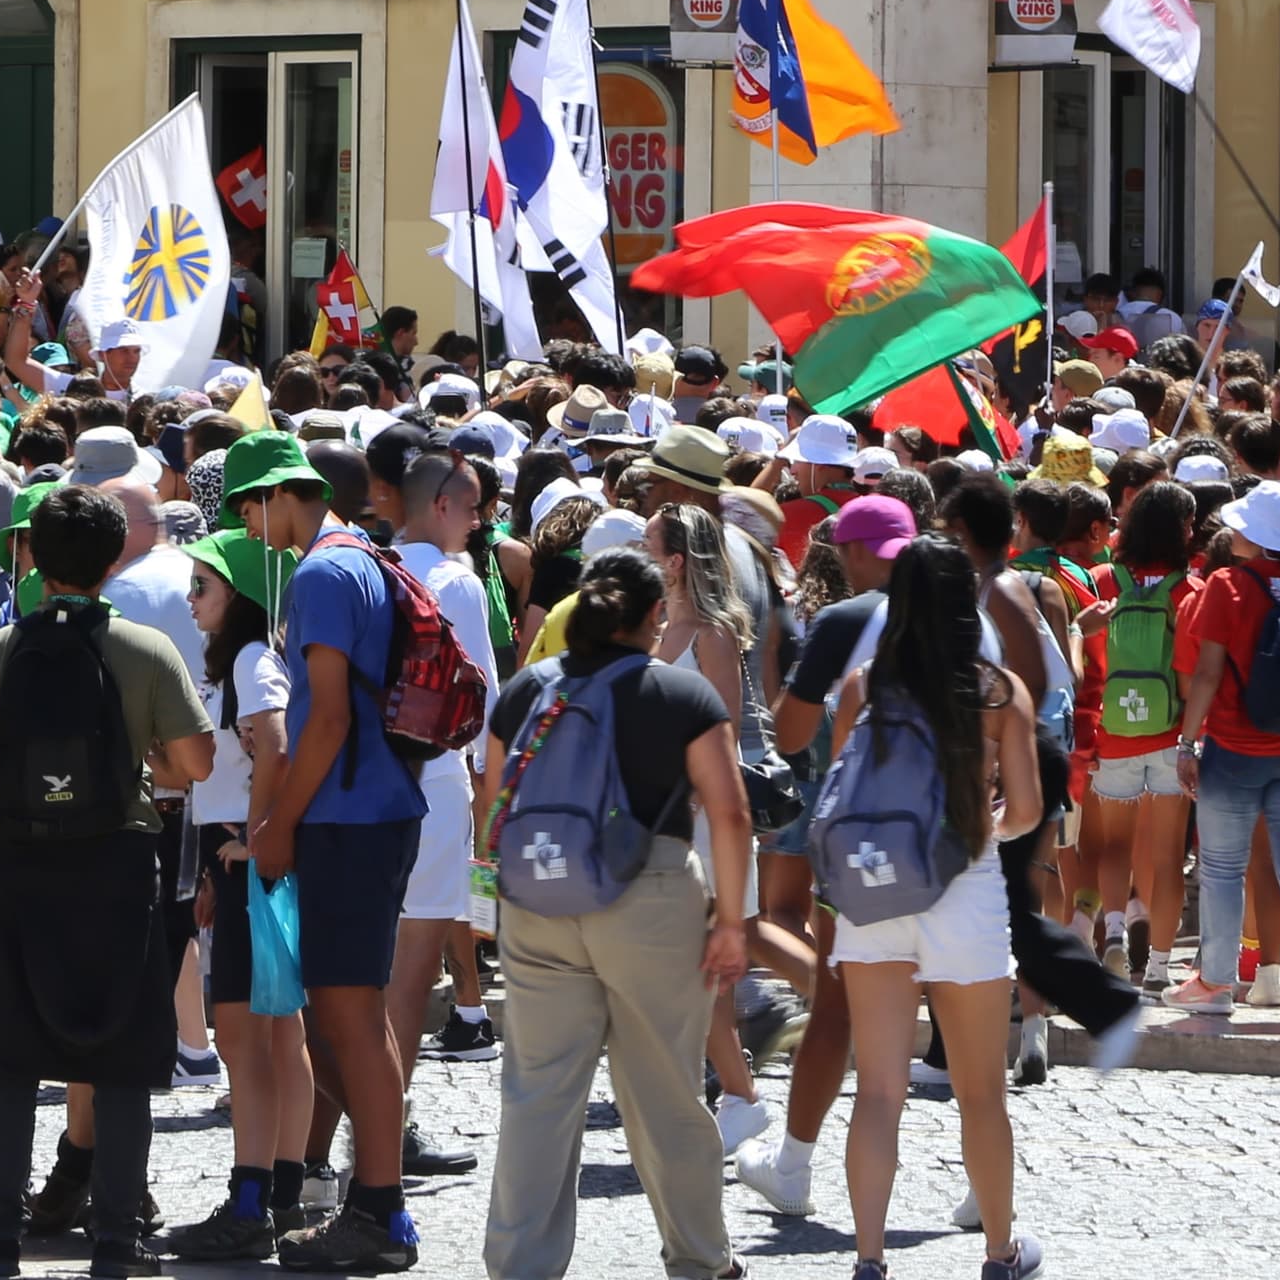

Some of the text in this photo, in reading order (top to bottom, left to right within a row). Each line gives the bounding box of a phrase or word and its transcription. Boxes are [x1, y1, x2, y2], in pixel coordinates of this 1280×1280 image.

[690, 1, 723, 13] KING
[1016, 3, 1056, 16] KING
[607, 132, 667, 171] GER
[608, 173, 666, 229] NG
